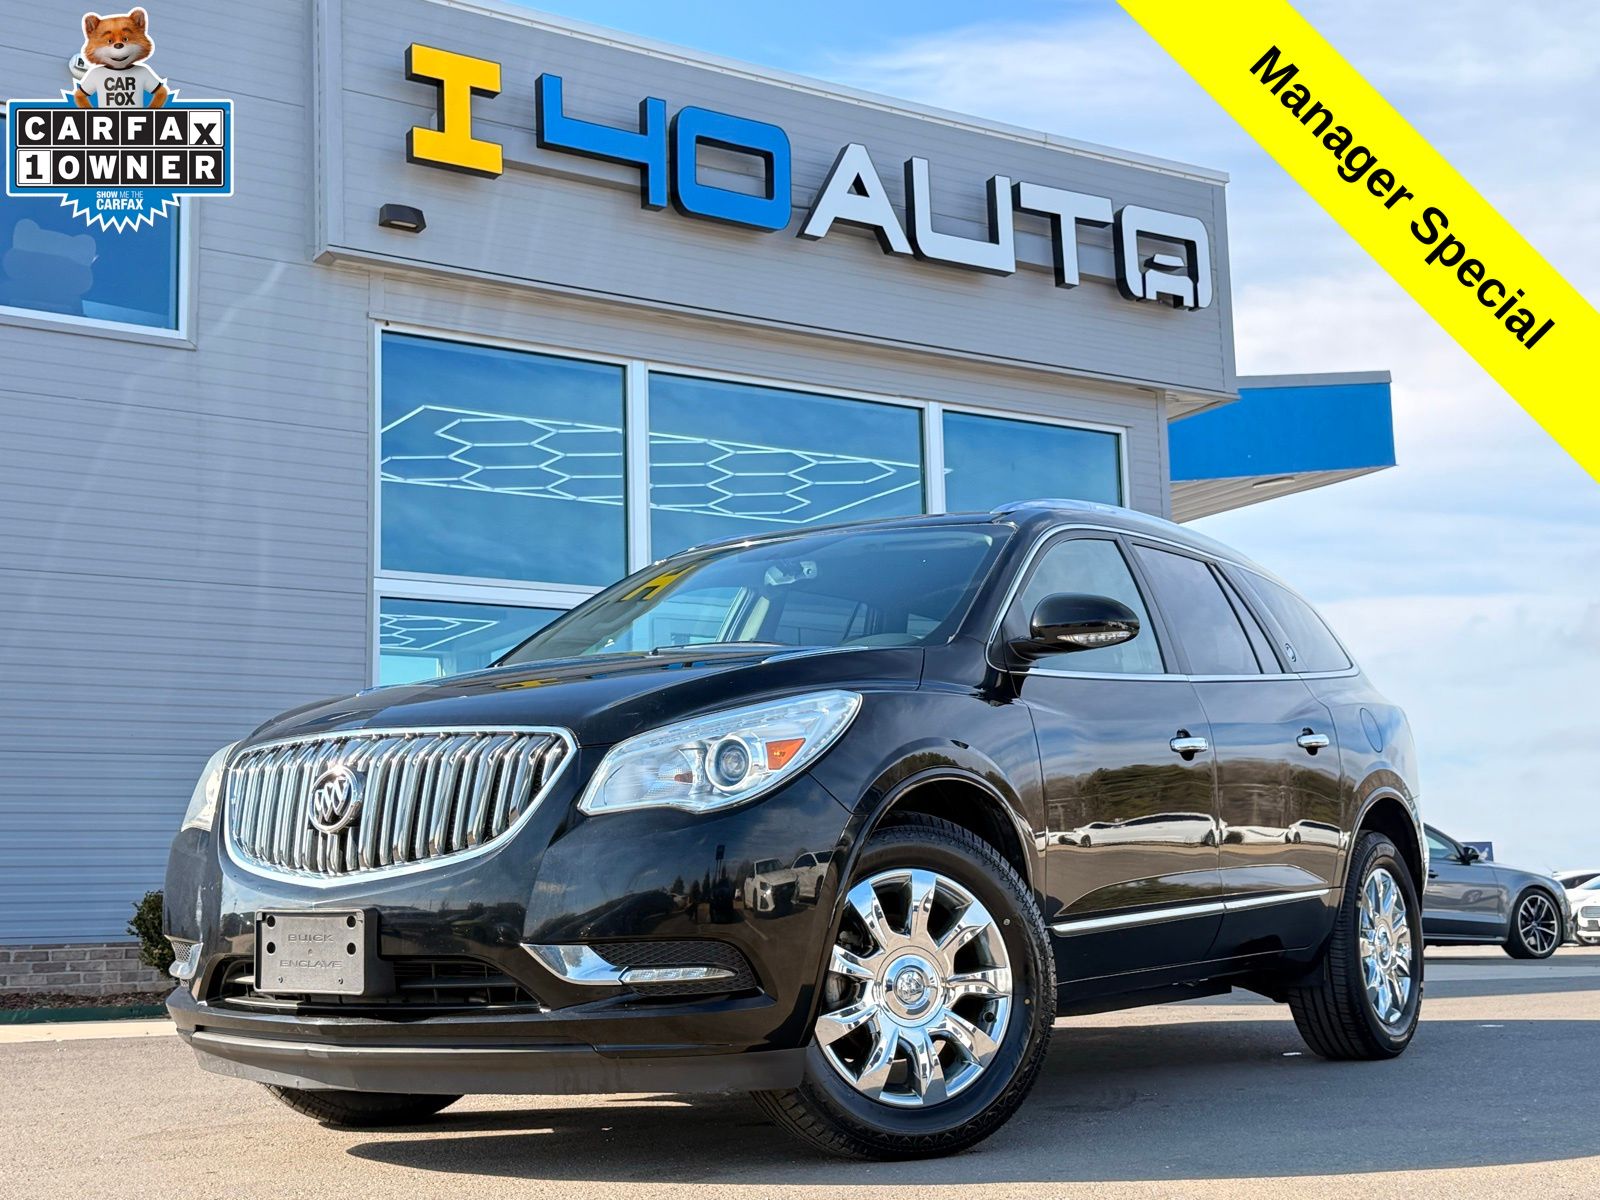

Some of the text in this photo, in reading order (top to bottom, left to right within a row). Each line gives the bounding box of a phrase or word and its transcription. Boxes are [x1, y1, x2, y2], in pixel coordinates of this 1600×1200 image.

[405, 43, 504, 179] I
[535, 72, 793, 233] 40
[287, 933, 334, 942] BUICK
[280, 959, 343, 969] ENCLAVE
